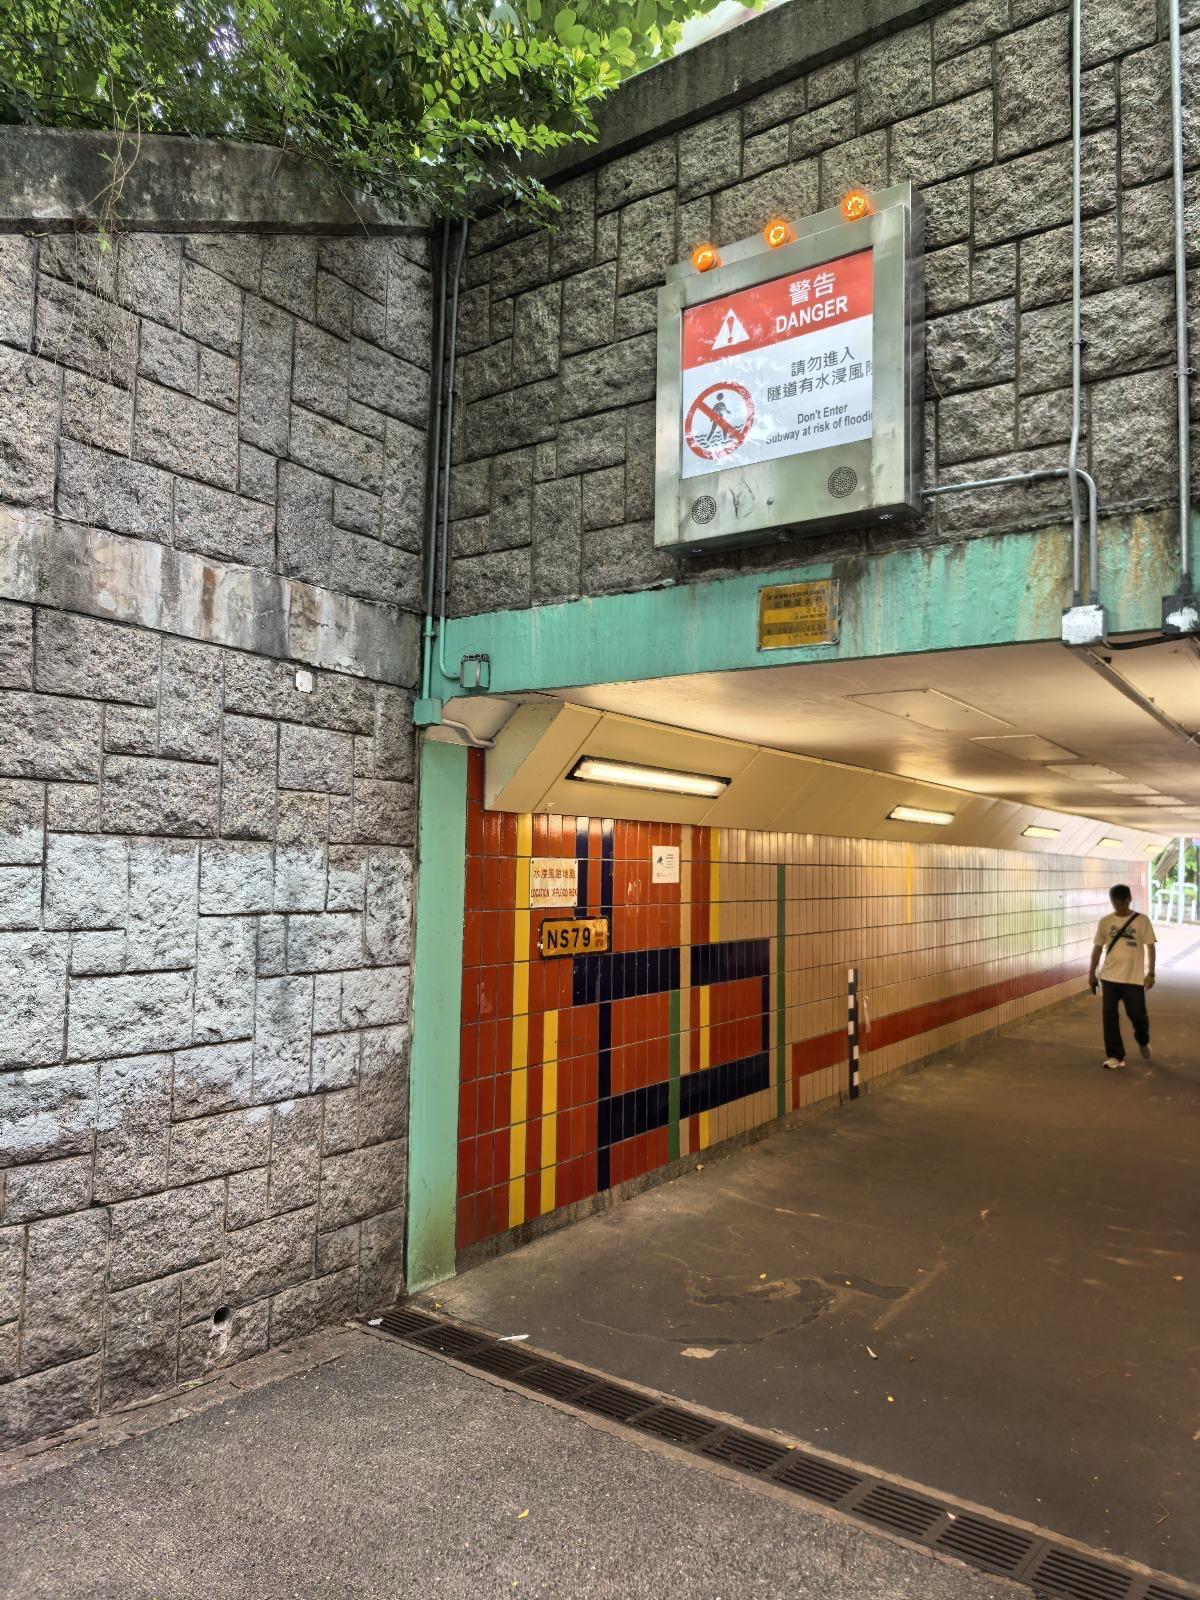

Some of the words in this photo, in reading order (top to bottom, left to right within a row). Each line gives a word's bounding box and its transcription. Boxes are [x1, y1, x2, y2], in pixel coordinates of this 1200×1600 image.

[789, 272, 836, 306] 警告
[775, 295, 848, 333] DANGER
[791, 346, 855, 377] 請勿進入
[797, 410, 821, 424] Don't
[823, 404, 848, 418] Enter
[766, 429, 800, 445] Subway
[802, 425, 811, 437] at
[813, 421, 830, 434] risk
[832, 417, 842, 429] of
[547, 926, 591, 949] NS79
